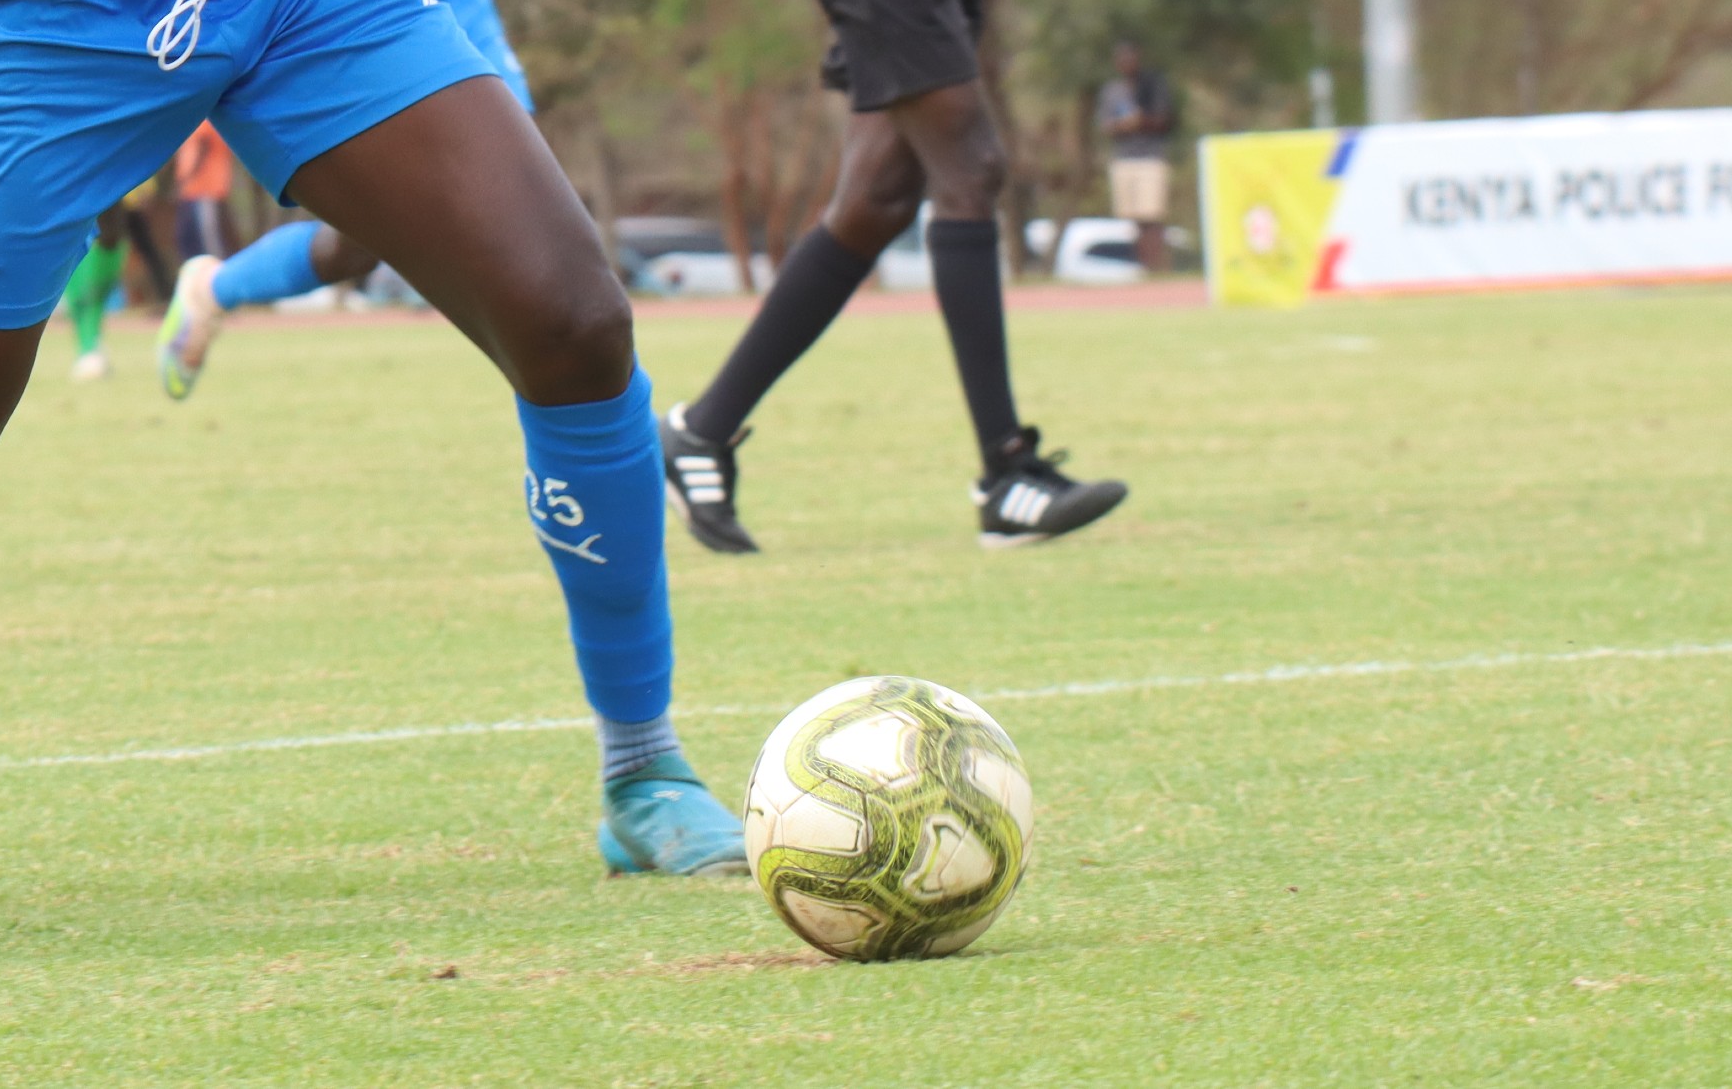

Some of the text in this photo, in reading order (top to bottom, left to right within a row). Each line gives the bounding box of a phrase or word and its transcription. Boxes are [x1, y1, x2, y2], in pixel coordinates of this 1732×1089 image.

[1402, 160, 1732, 224] KENYA POLICE F
